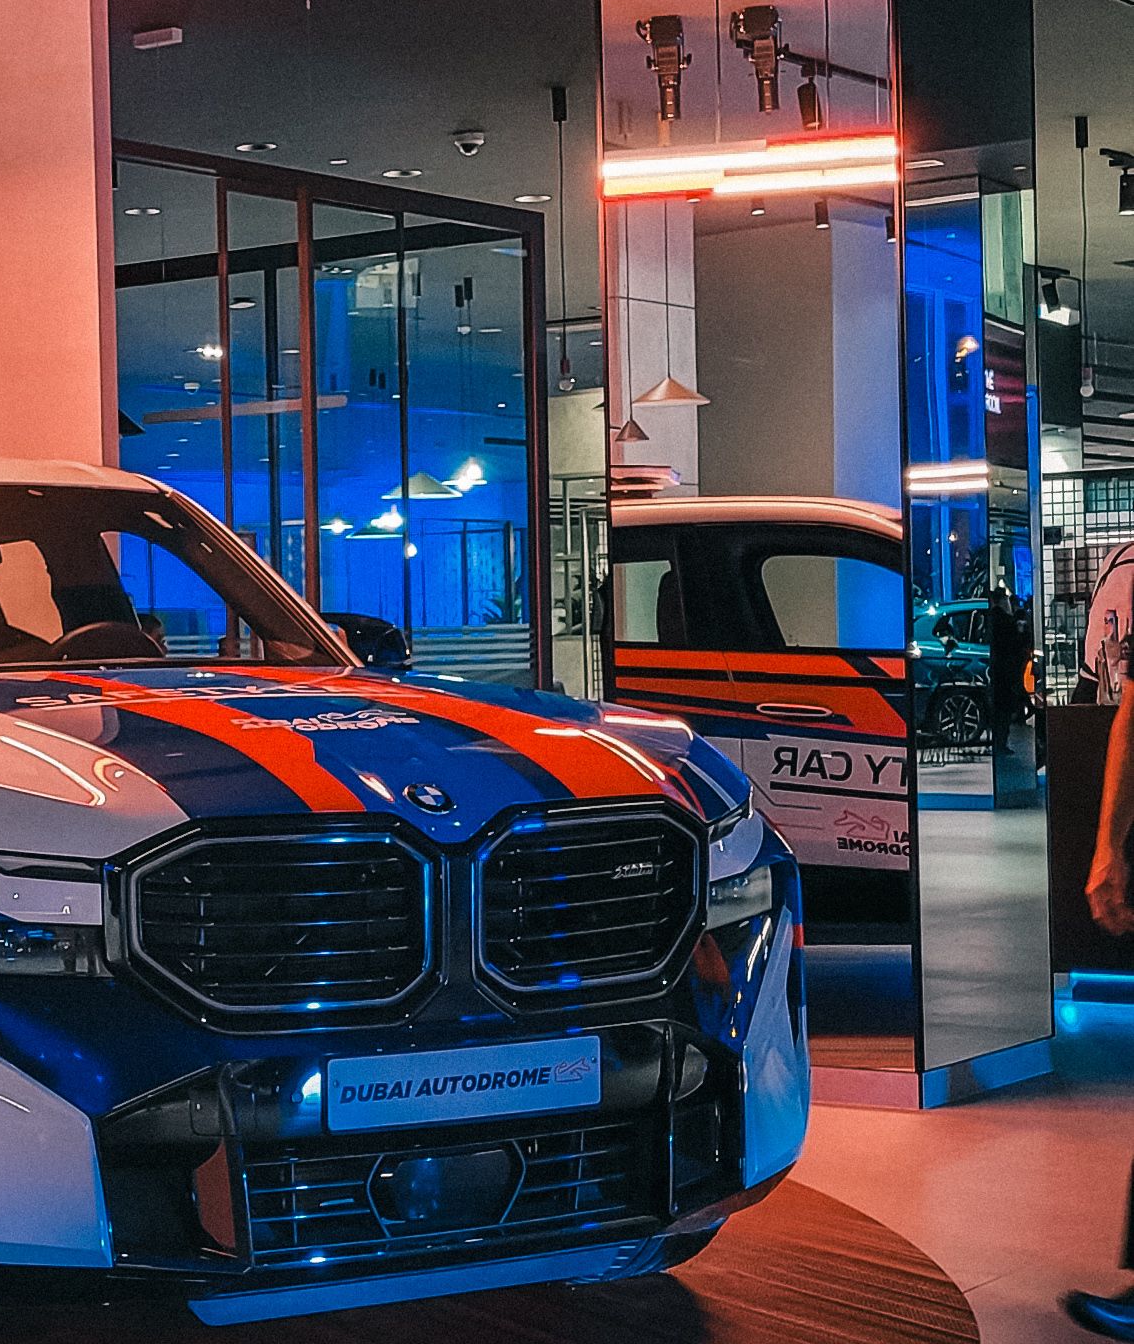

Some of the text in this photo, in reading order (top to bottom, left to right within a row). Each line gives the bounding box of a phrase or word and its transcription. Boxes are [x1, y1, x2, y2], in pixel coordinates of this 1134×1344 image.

[15, 685, 274, 707] SAFETY
[340, 1066, 551, 1104] DUBAI AUTODROME
